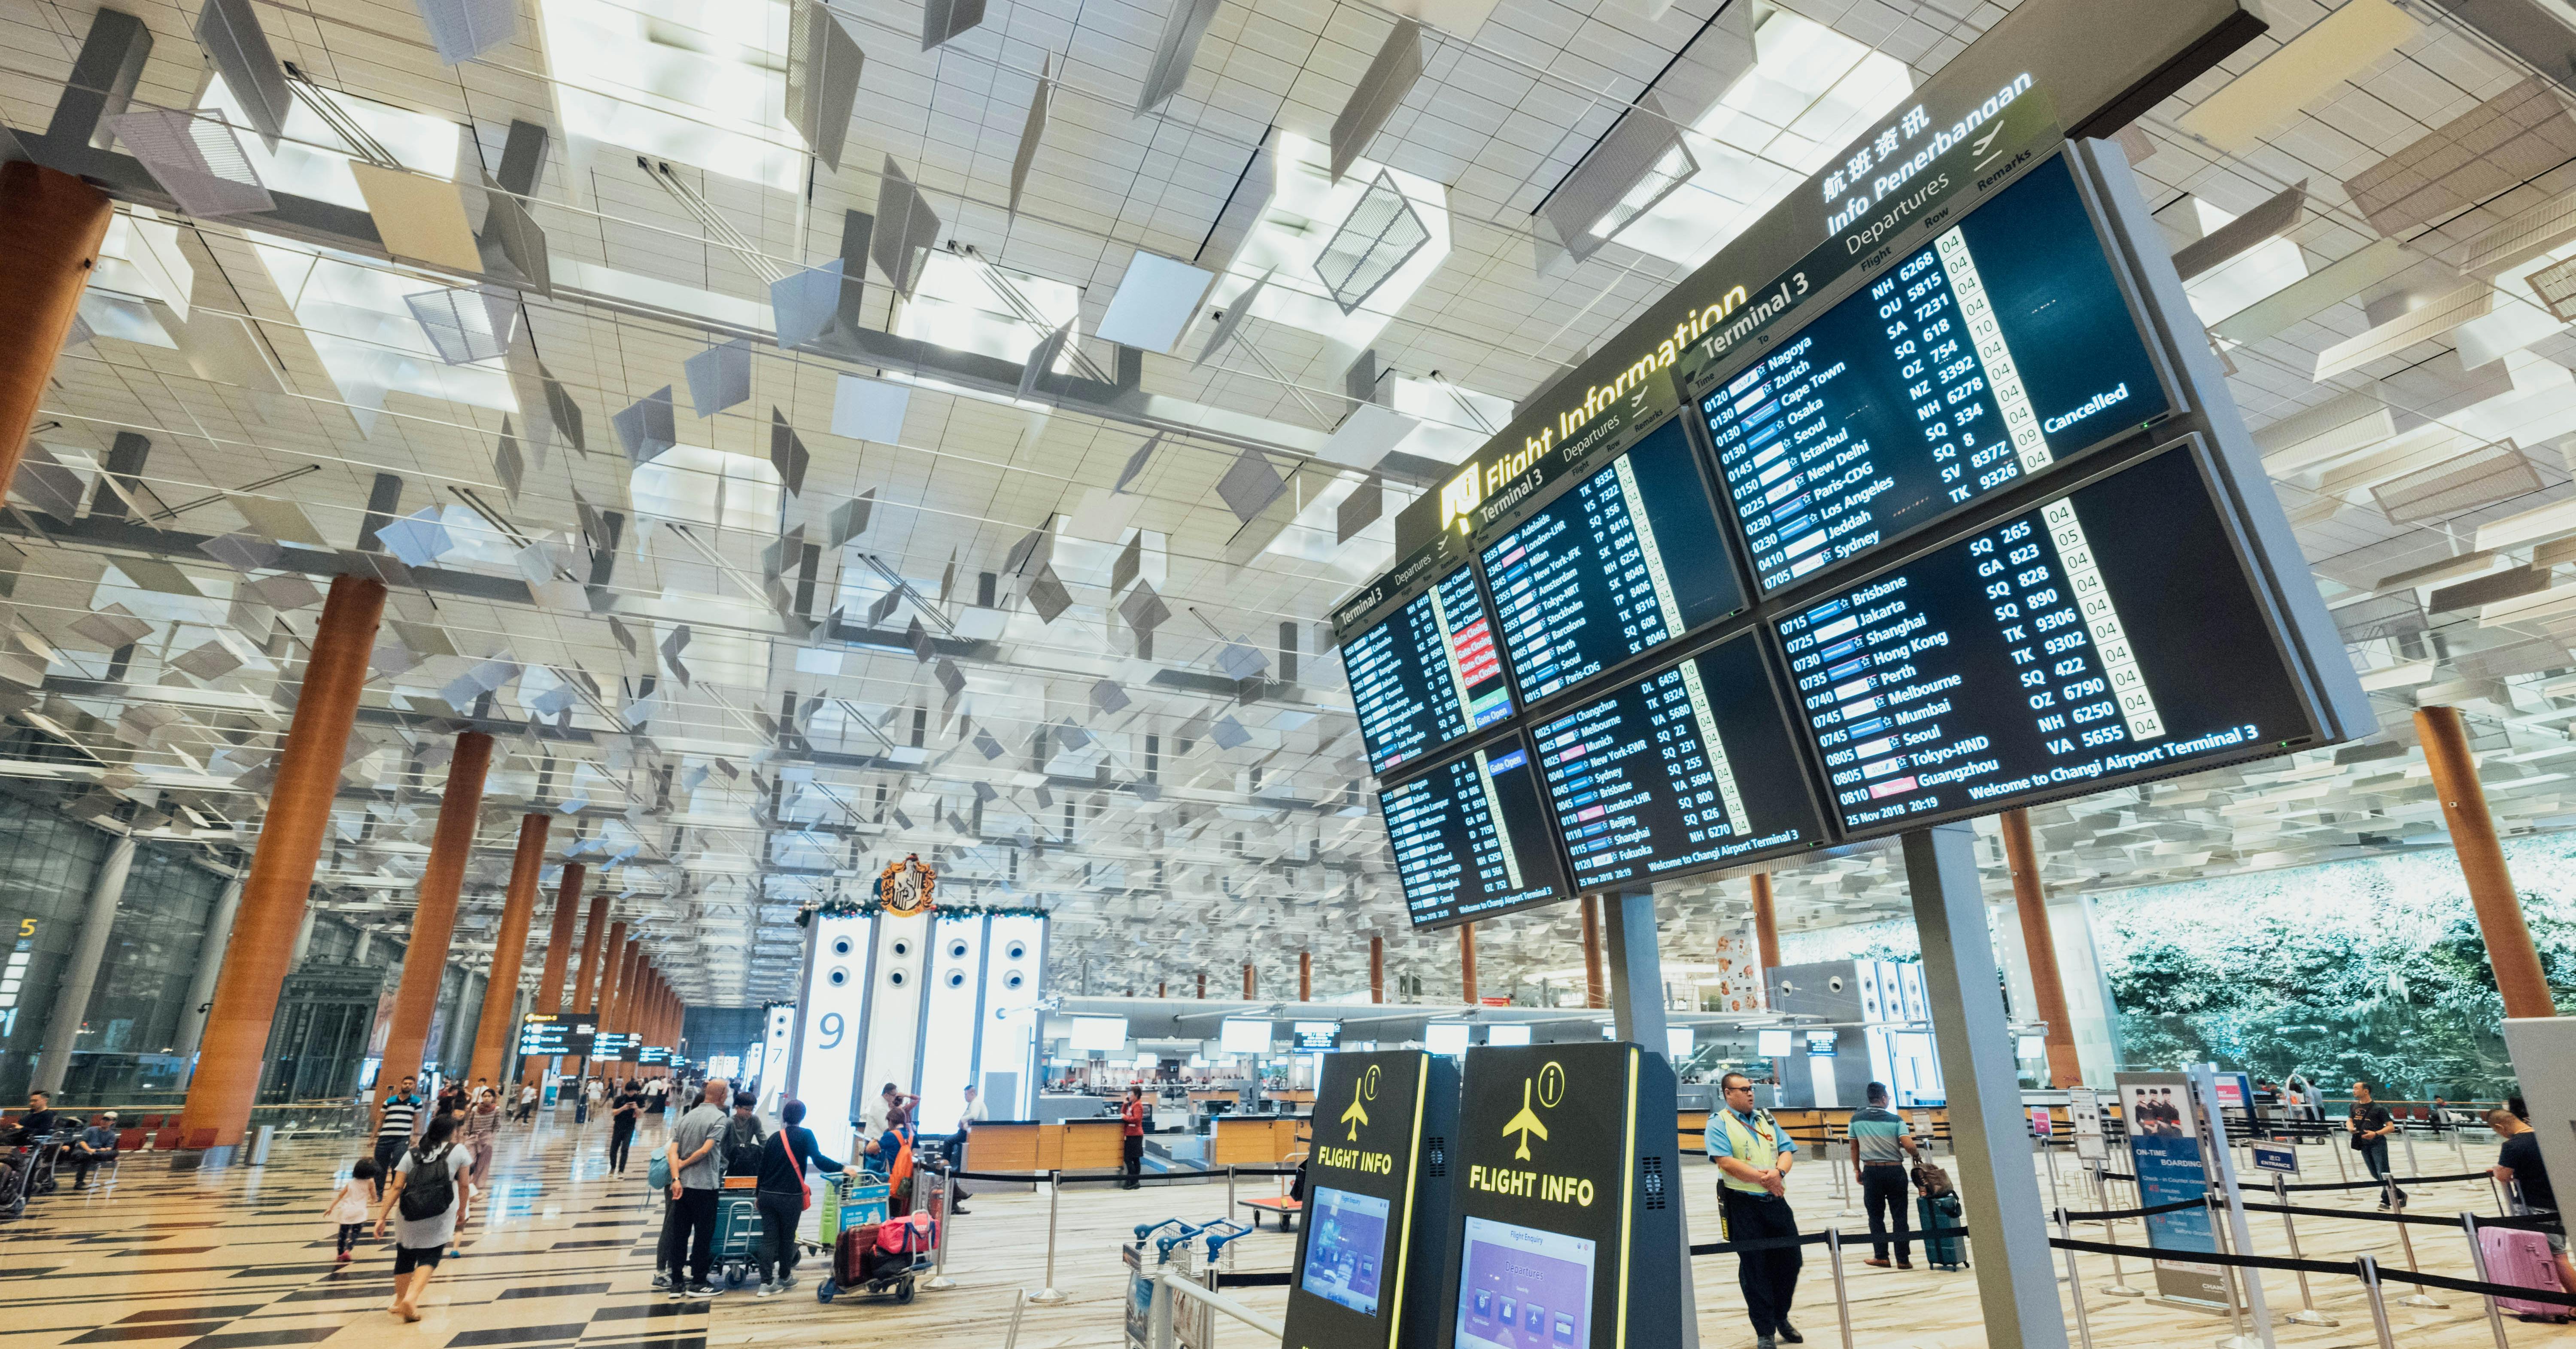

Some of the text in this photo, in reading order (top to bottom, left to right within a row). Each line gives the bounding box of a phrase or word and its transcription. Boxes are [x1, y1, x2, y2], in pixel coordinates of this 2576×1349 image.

[1823, 104, 1930, 203] 航班资讯
[1828, 196, 1869, 236] Info
[1846, 172, 1949, 254] Departures
[1696, 149, 2032, 388] Time To Flight Row Remarks
[1701, 272, 1809, 359] Terminal 3
[1704, 235, 1959, 412] 0120 Nagoya NH 6268 04
[1486, 285, 1747, 496] Flight Information
[1722, 298, 1984, 464] 0130 Osaka SQ 618 04
[1563, 414, 1620, 462] Departures
[1477, 534, 1488, 543] Time
[1572, 461, 1589, 476] Flight
[1607, 439, 1620, 452] Row
[1634, 408, 1663, 432] Remarks
[1481, 469, 1543, 523] Terminal 3
[1752, 407, 2028, 553] 0230 Los Angeles SQ 8 04
[1758, 382, 2129, 571] 0410 Jeddah SV 837Z 09 Cancelled
[1482, 460, 1628, 563] 2335 Adelaide TK 9332 04
[1395, 554, 1431, 585] Departures
[1780, 506, 2069, 635] 0715 Brisbane SQ 265 04
[1341, 587, 1382, 624] Terminal 3
[1344, 645, 1355, 657] 1950
[1368, 623, 1388, 641] Mumbai
[1406, 603, 1416, 615] NH
[1416, 594, 1429, 608] 6419
[1438, 581, 1452, 597] Gate
[1452, 566, 1470, 585] Closed
[1453, 619, 1488, 647] Gate Closing
[1800, 576, 2097, 691] 0735 Hong Kong SQ 890 04
[1524, 623, 1681, 703] 0015 Paris-CDG SK 8046 04
[1472, 695, 1499, 713] Boarding
[1534, 664, 1694, 739] 0025 Changchun DL 6459 10
[1374, 761, 1386, 773] 2115
[1400, 747, 1422, 761] Brisbane
[1441, 731, 1452, 741] VA
[1452, 724, 1466, 737] 5663
[1476, 715, 1491, 726] Gate
[1490, 707, 1507, 720] Open
[1840, 788, 1869, 805] 0810
[1918, 759, 1999, 786] Guangzhou
[2046, 738, 2075, 755] VA
[2081, 725, 2124, 747] 5655
[2135, 719, 2157, 734] 04
[1968, 725, 2258, 799] Welcome to Changi Airport Terminal 3
[1412, 792, 1431, 804] Jakarta
[1454, 777, 1461, 787] JT
[1464, 771, 1476, 782] 159
[1489, 762, 1504, 773] Gate
[1504, 755, 1522, 768] Open
[1561, 767, 1729, 826] 0110 London-LHR VA 5684 04
[1846, 796, 1938, 825] 25 Nov 2018 20:19
[18, 919, 37, 936] 5
[772, 1048, 782, 1064] 7
[819, 1013, 844, 1049] 9
[1318, 1146, 1391, 1175] FLIGHT INFO
[2136, 1148, 2167, 1157] ON-TIME
[2161, 1159, 2202, 1168] BOARDING
[2261, 1160, 2291, 1168] ENTRANCE
[1470, 1165, 1594, 1206] FLIGHT INFO
[1510, 1230, 1543, 1245] Flight Enquiry
[1505, 1261, 1543, 1280] Departures
